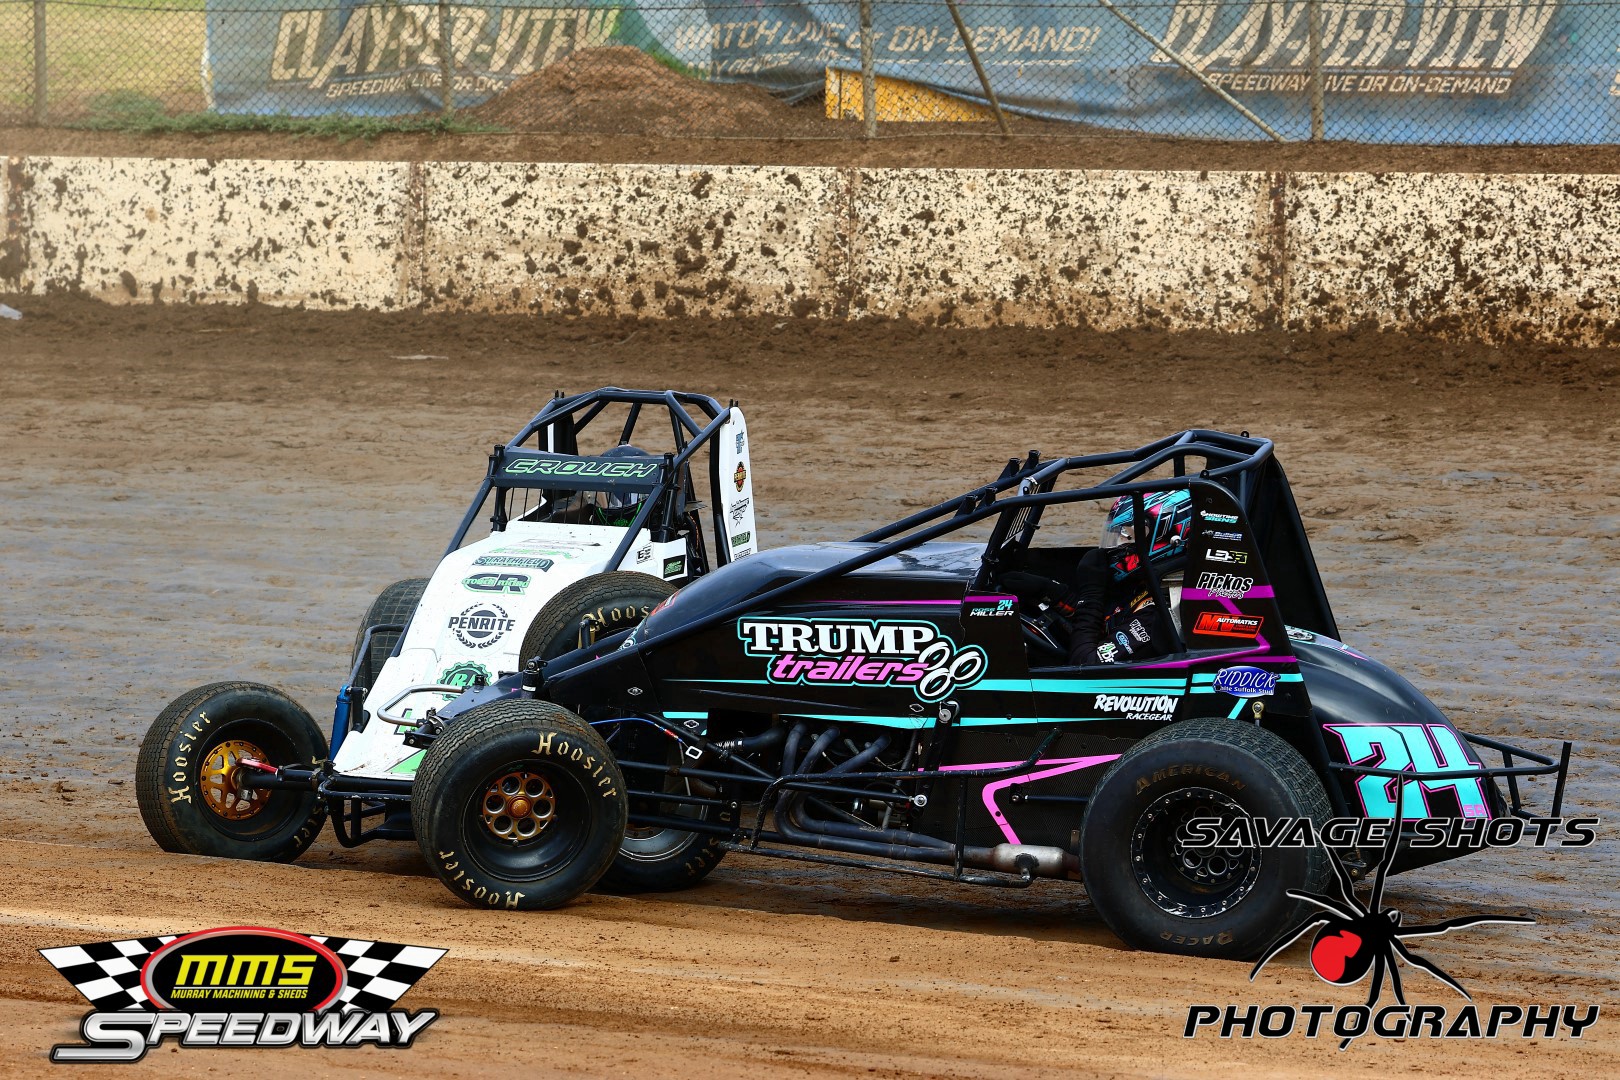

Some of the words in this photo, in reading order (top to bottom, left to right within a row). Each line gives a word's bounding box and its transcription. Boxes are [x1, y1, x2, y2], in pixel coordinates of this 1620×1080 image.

[675, 20, 783, 50] WATCH
[888, 25, 1100, 52] ON-DEMAND!
[1150, 0, 1556, 71] CLAY-PER-VIEW
[1324, 75, 1357, 92] IVE
[1358, 75, 1388, 92] OR
[1389, 76, 1512, 94] ON-DEMAND
[505, 458, 657, 477] CROUCH
[997, 600, 1013, 611] 24
[448, 616, 516, 631] PENRITE
[1216, 617, 1258, 626] AUTOMATICS
[743, 622, 934, 654] TRUMP
[772, 654, 930, 682] trailers
[1213, 668, 1276, 688] RIDDICK
[1093, 694, 1179, 713] REVOLUTION
[1125, 712, 1173, 722] RACEGEAR
[168, 711, 211, 804] Hoosier
[531, 731, 617, 798] Hoosier
[1322, 723, 1492, 821] 24
[439, 851, 526, 909] Hoosier
